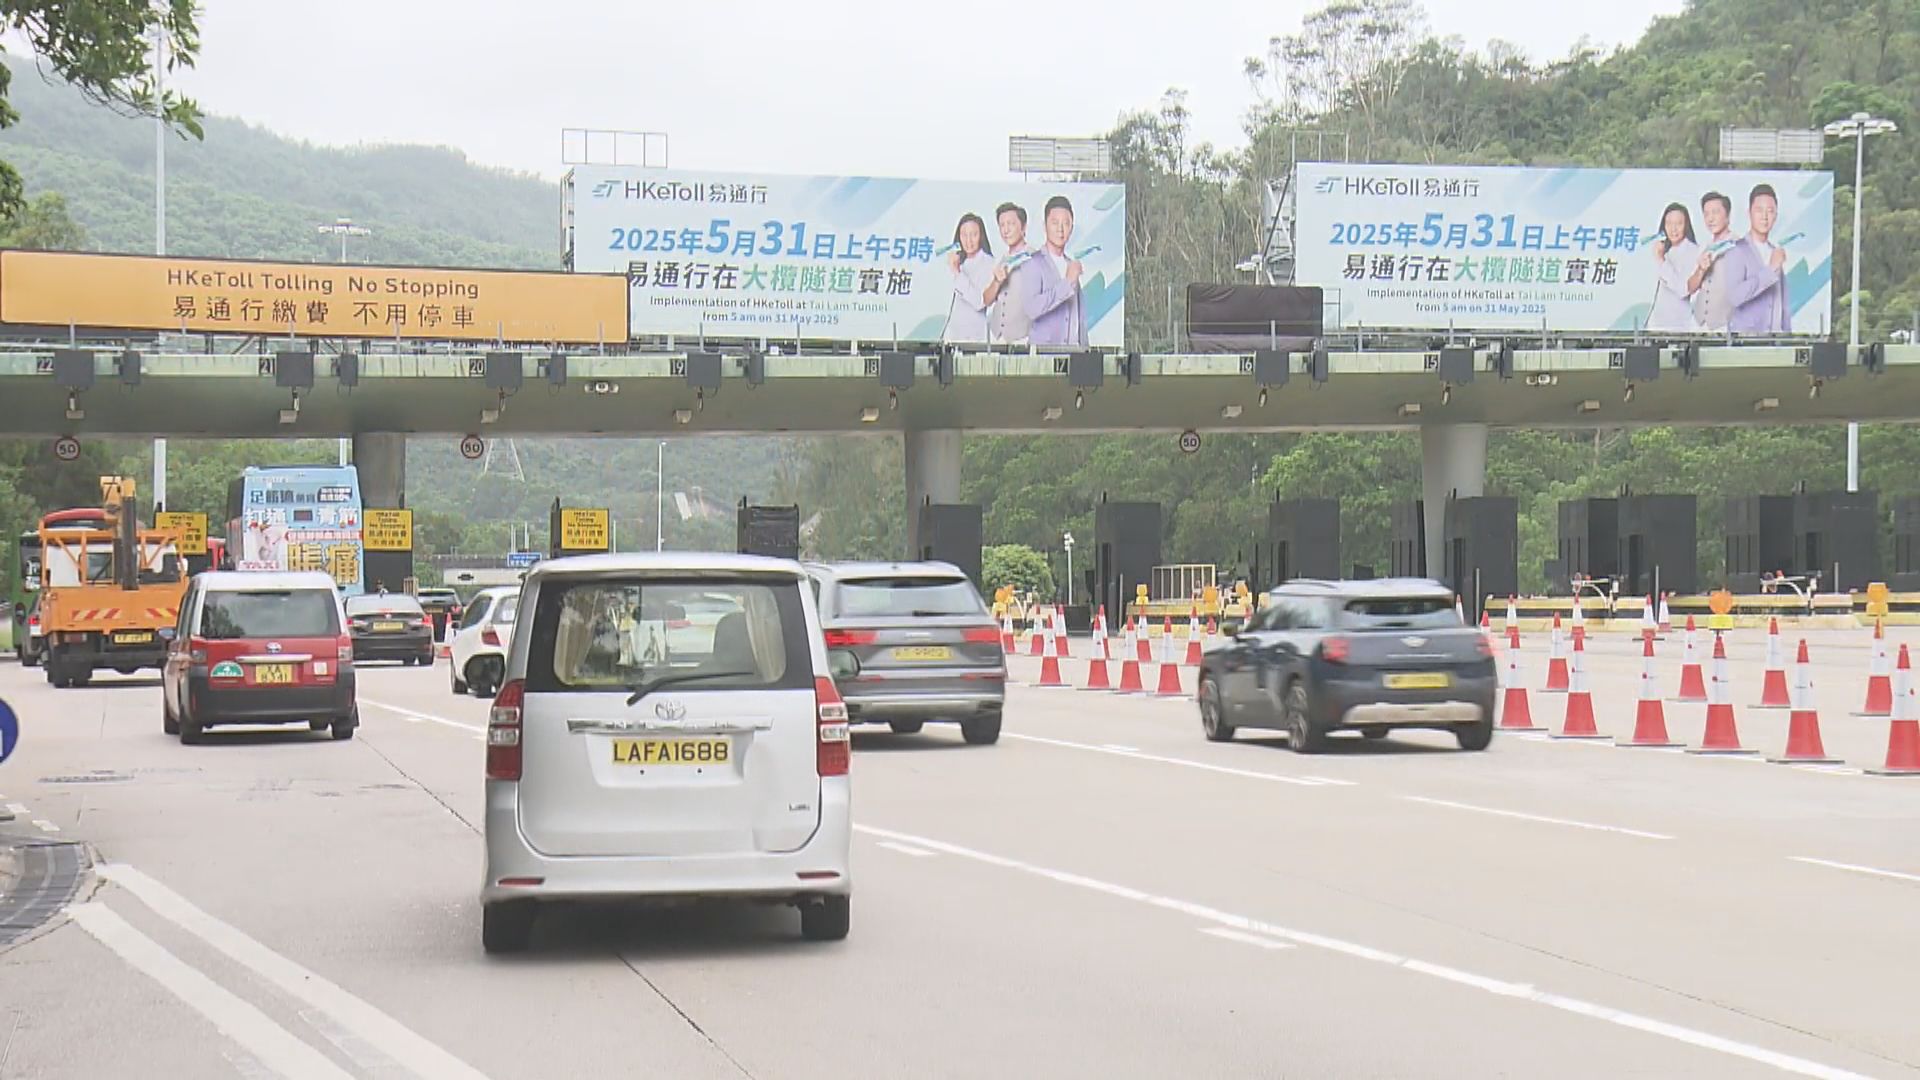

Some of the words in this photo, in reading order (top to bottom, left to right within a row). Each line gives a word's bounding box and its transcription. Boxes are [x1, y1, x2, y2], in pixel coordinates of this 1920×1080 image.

[625, 181, 704, 201] HKeToll
[709, 184, 768, 203] 易通行
[1345, 177, 1419, 195] HKeToll
[1424, 178, 1480, 197] 易通行
[1329, 212, 1640, 252] 2025年5月31日上午5時
[609, 219, 935, 263] 2025年5月31日上午5時
[1342, 254, 1618, 285] 易通行在大欖隧道實施
[167, 269, 253, 288] HKeToll
[261, 274, 333, 294] Tolling
[349, 276, 377, 293] No
[385, 278, 479, 299] Stopping
[1367, 288, 1449, 300] Implementation
[1451, 289, 1462, 299] of
[1464, 289, 1502, 299] HKeToll
[1504, 291, 1515, 299] at
[650, 295, 737, 308] Implementation
[739, 297, 751, 308] of
[753, 298, 793, 309] HKeToll
[796, 300, 807, 309] at
[852, 302, 888, 313] Tunnel
[1416, 302, 1440, 311] from
[1443, 303, 1449, 312] 5
[1451, 304, 1467, 312] am
[1469, 304, 1482, 312] on
[1484, 303, 1496, 313] 31
[1499, 303, 1519, 315] May
[1521, 304, 1546, 313] 2025
[173, 296, 329, 324] 易通行繳費
[353, 301, 476, 329] 不用停車
[702, 311, 728, 321] from
[731, 312, 737, 321] 5
[740, 314, 756, 322] am
[758, 314, 772, 323] on
[775, 313, 787, 323] 31
[789, 314, 811, 325] May
[813, 315, 839, 325] 2025
[38, 357, 53, 371] 22
[470, 358, 484, 373] 20
[671, 358, 684, 374] 19
[866, 358, 877, 374] 18
[1054, 358, 1065, 373] 17
[1241, 358, 1253, 372] 16
[1425, 355, 1437, 368] 15
[1611, 353, 1621, 366] 14
[59, 444, 75, 455] 50
[464, 444, 480, 454] 50
[1183, 438, 1197, 448] 50
[614, 742, 729, 761] LAFA1688
